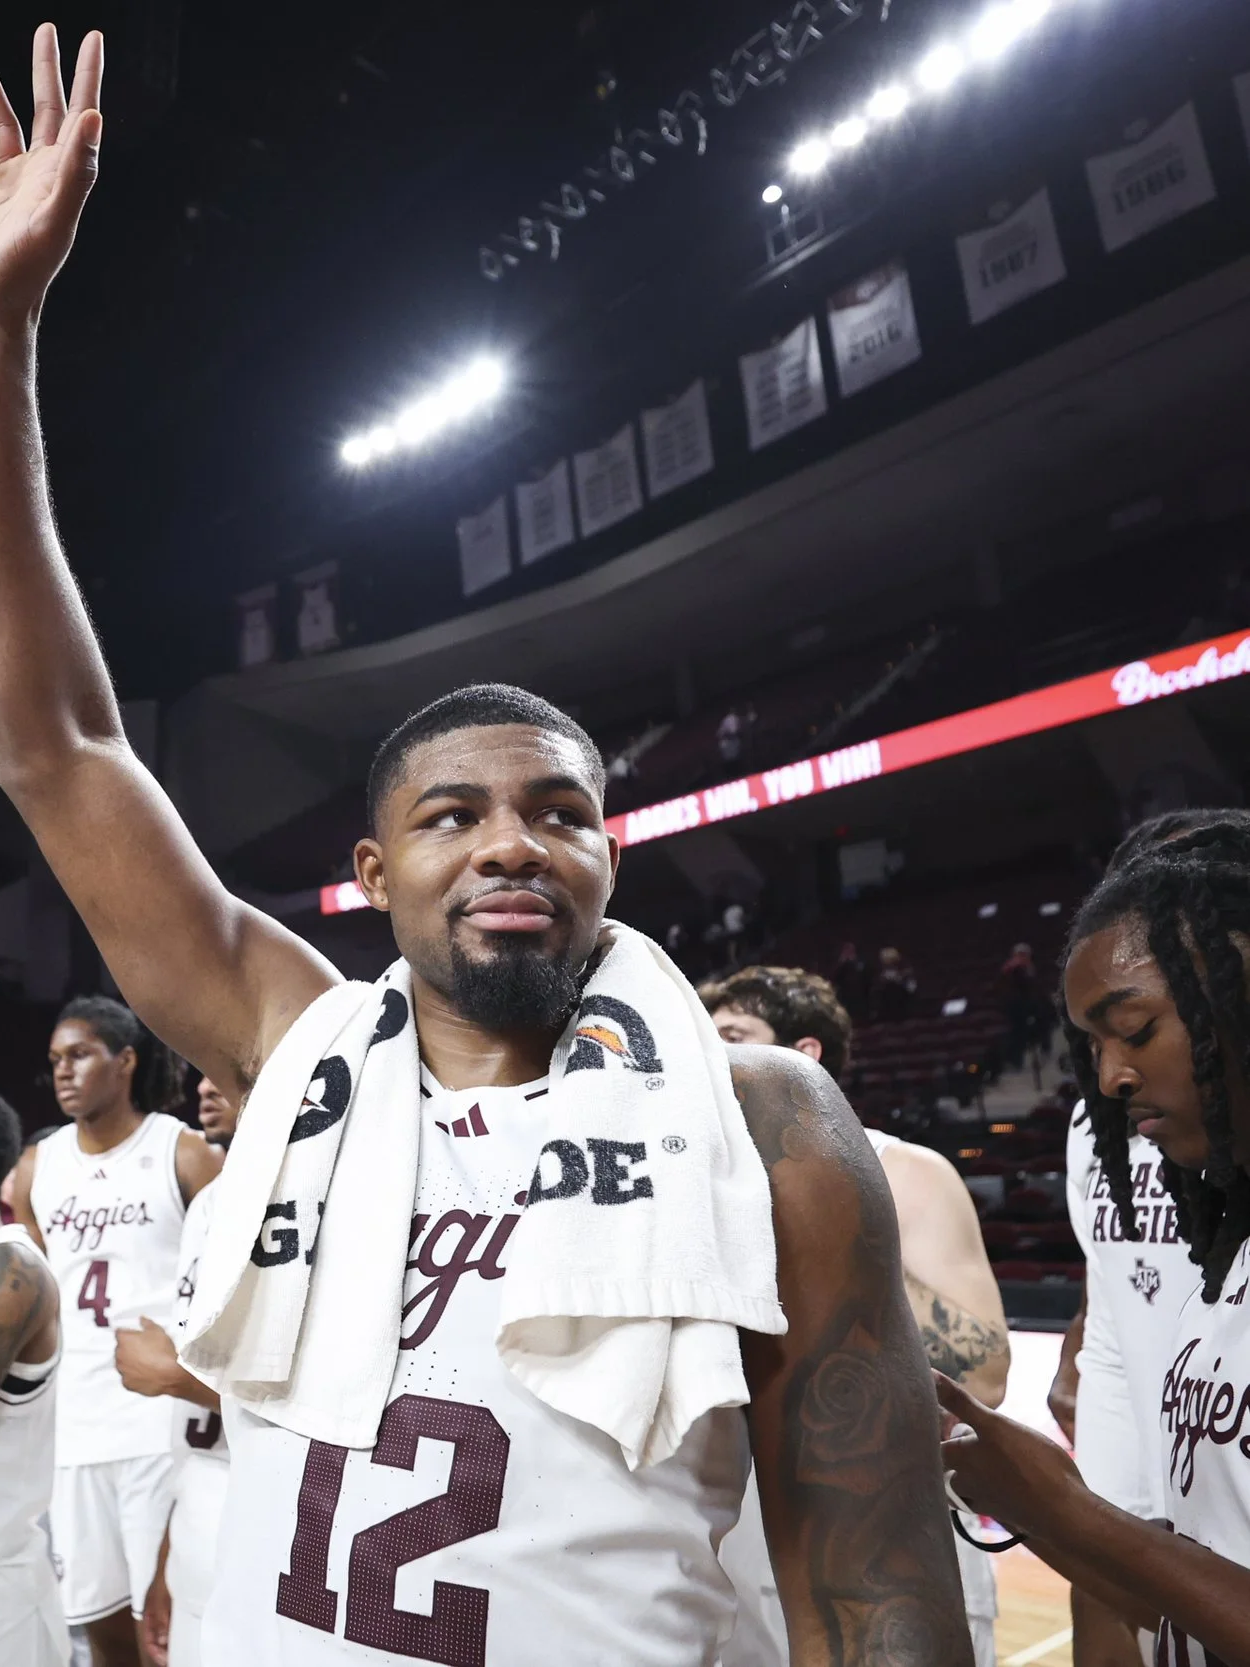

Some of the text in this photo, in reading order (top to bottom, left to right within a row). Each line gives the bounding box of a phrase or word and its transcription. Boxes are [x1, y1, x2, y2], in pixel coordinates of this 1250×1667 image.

[761, 760, 814, 805] YOU
[46, 1195, 154, 1252] Aggies
[1093, 1205, 1179, 1243] AGGIE
[78, 1260, 111, 1327] 4
[276, 1393, 510, 1667] 12
